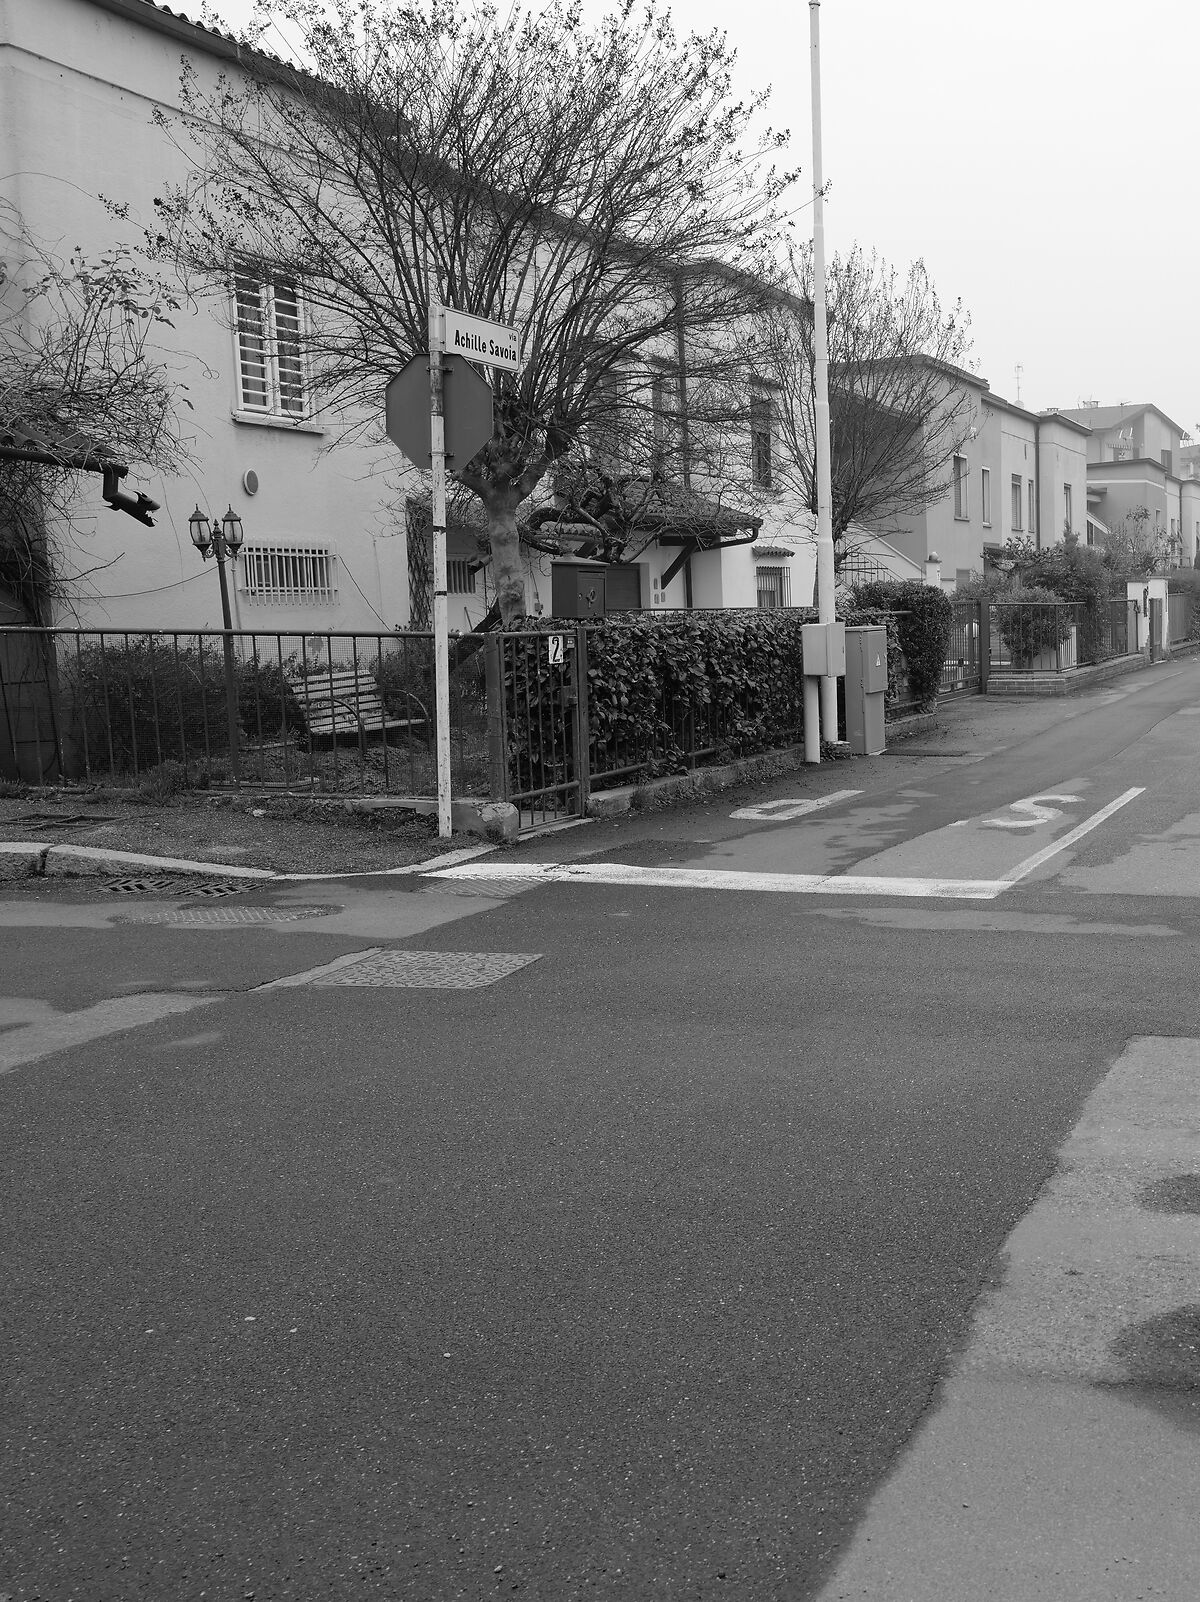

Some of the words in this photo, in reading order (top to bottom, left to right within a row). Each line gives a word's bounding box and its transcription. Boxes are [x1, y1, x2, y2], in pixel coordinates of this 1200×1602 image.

[454, 329, 487, 353] Achille
[489, 339, 517, 361] Savoia
[508, 332, 517, 342] via
[552, 636, 561, 662] 2
